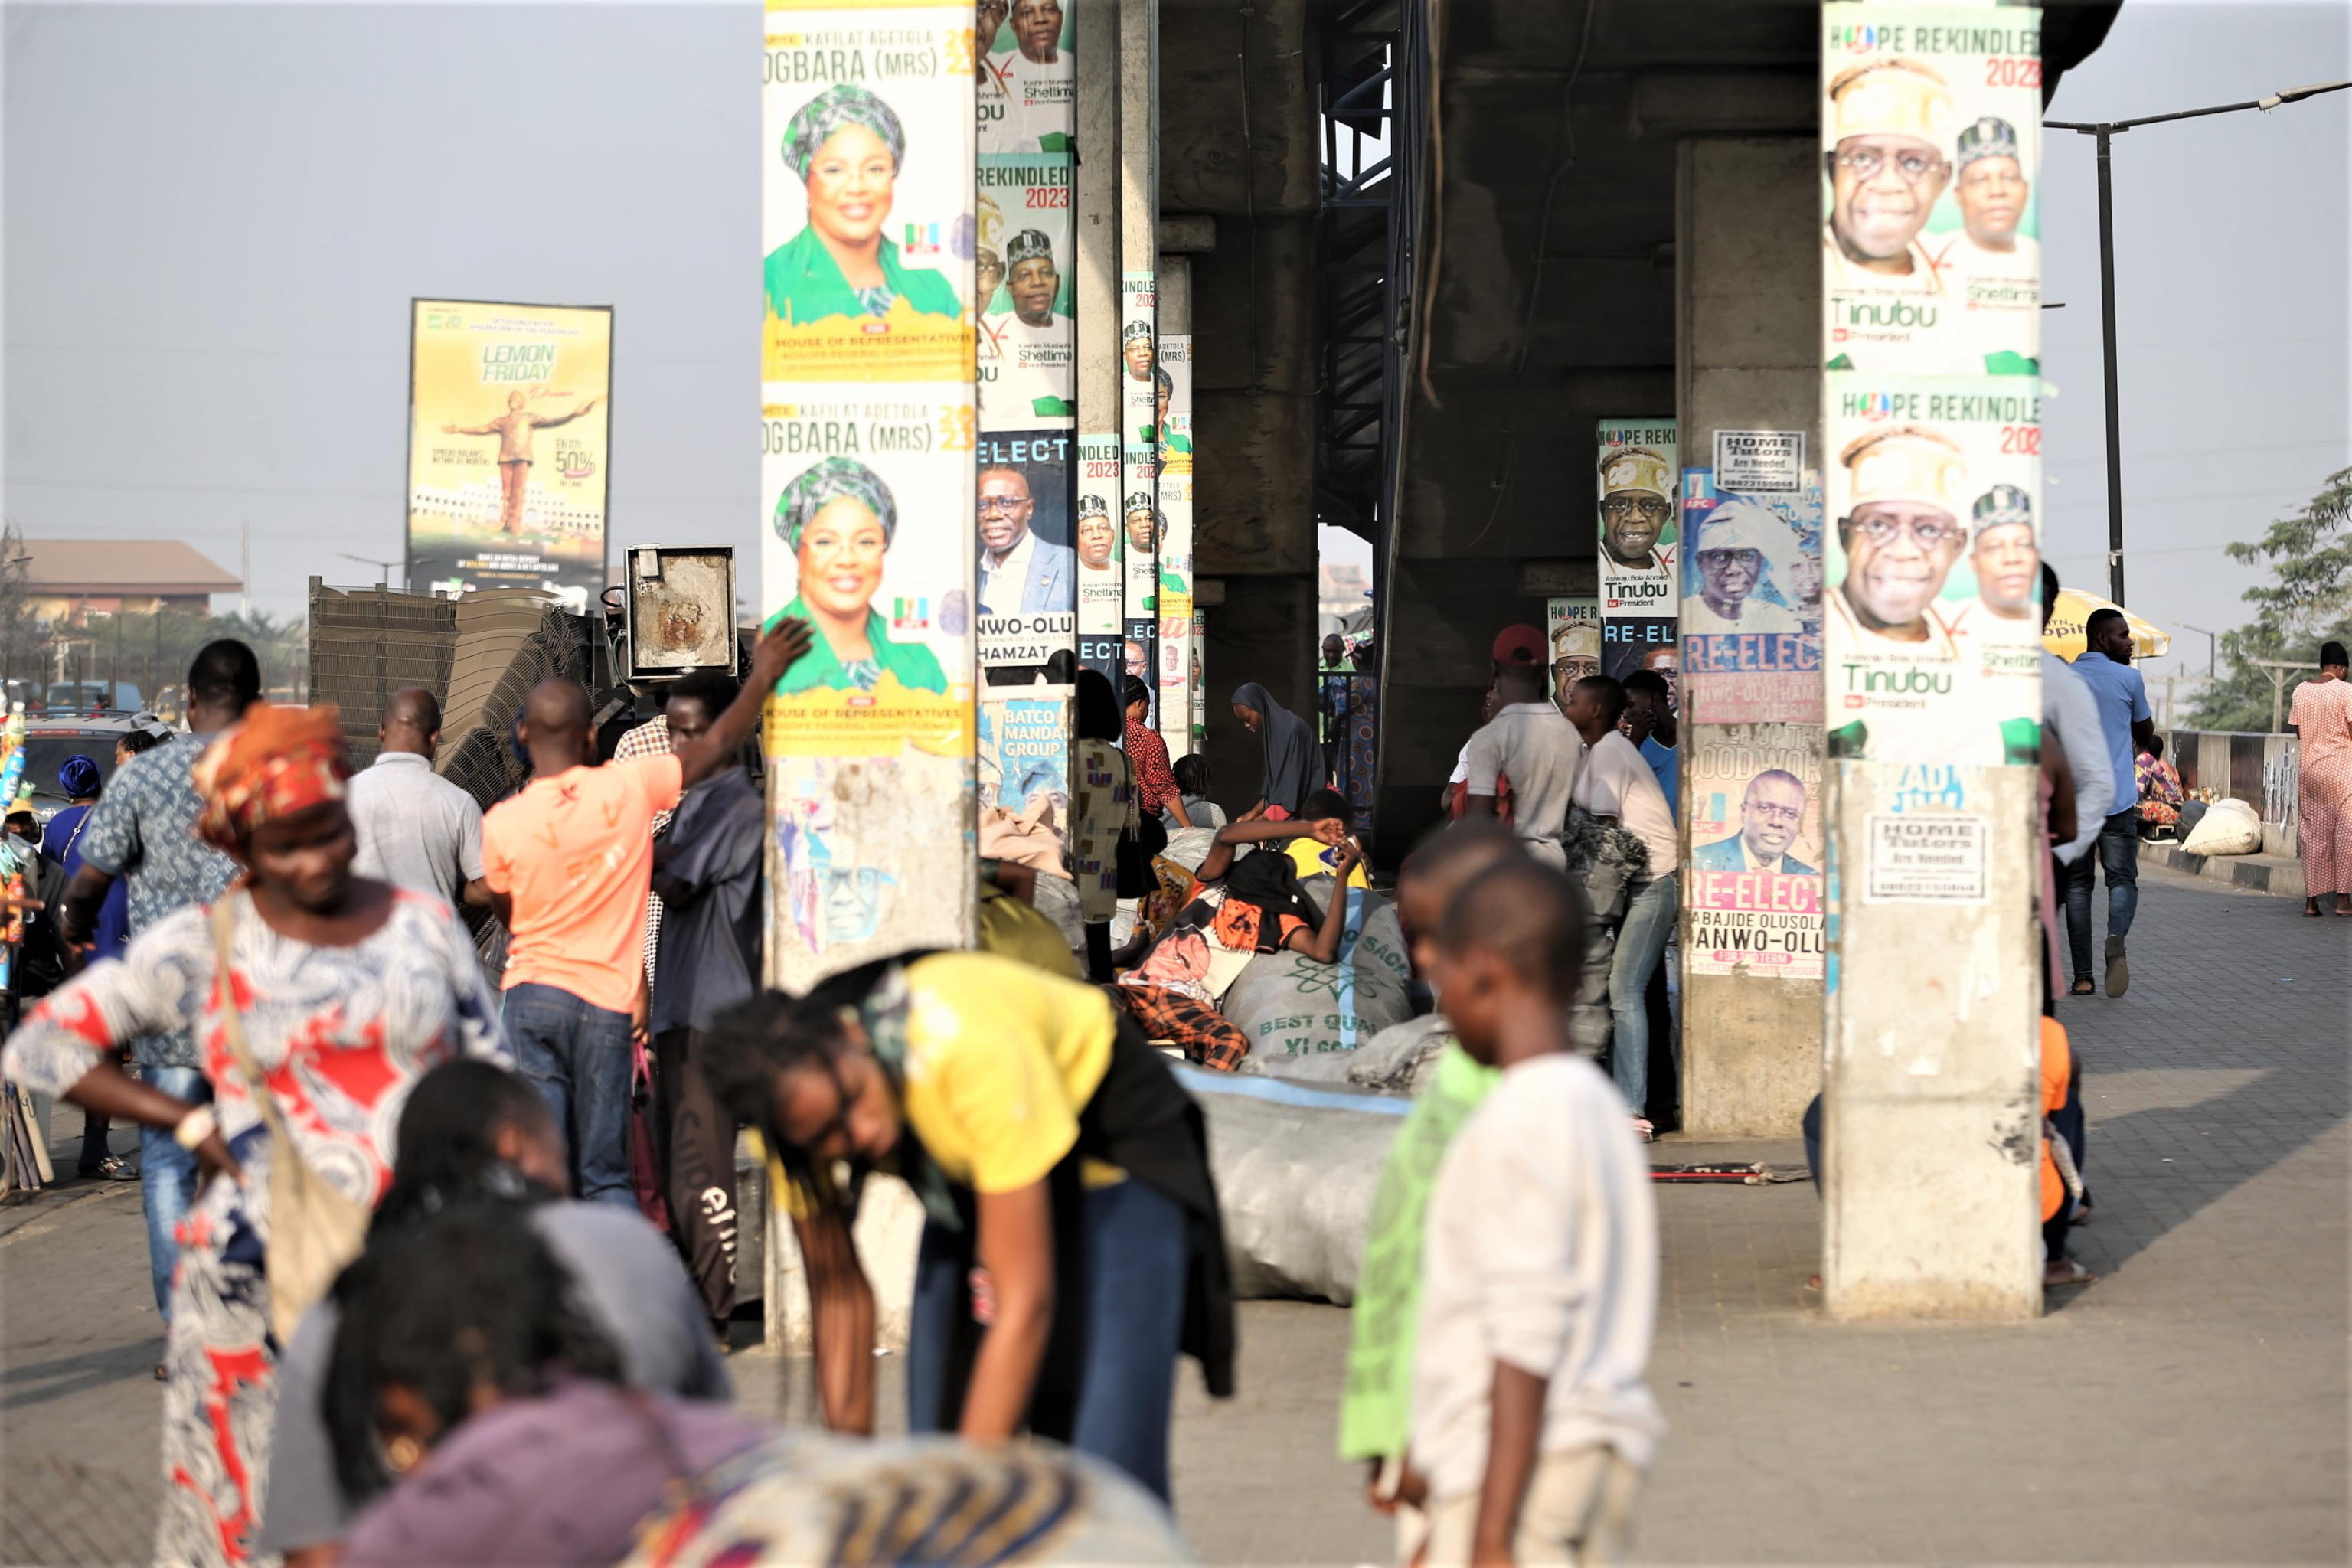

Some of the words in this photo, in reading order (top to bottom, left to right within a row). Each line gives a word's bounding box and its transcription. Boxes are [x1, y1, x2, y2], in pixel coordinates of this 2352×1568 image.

[1830, 25, 1906, 54] HOPE
[876, 47, 937, 79] (MRS)
[976, 166, 1069, 186] REKINDLED
[1026, 188, 1070, 208] 2023
[1831, 297, 1936, 328] Tinubu
[776, 338, 822, 348] HOUSE
[483, 345, 555, 364] LEMON
[1019, 350, 1073, 361] Shettima
[1161, 350, 1186, 363] (MRS)
[482, 363, 554, 381] FRIDAY
[800, 403, 858, 418] KAFILAT
[864, 403, 929, 418] ADETOLA
[1842, 392, 1921, 422] HOPE
[869, 422, 932, 454] (MRS)
[1599, 429, 1641, 447] HOPE
[1645, 429, 1676, 444] REKI
[1727, 438, 1792, 447] HOME
[978, 439, 1069, 463] ELECT
[1078, 446, 1119, 460] NDLED
[1727, 446, 1792, 456] Tutors
[556, 450, 596, 473] 50%
[1087, 461, 1119, 479] 2023
[1733, 459, 1749, 467] Are
[1687, 499, 1709, 508] APC
[1605, 581, 1668, 598] Tinubu
[1619, 599, 1654, 607] President
[1551, 606, 1586, 620] HOPE
[1590, 606, 1598, 619] R
[977, 617, 1072, 635] NWO-OLU
[1605, 626, 1674, 642] RE-EL
[978, 645, 1049, 660] HAMZAT
[1081, 642, 1122, 659] ECT
[1686, 635, 1816, 671] RE-ELEC
[1842, 664, 1952, 694] Tinubu
[1004, 710, 1055, 724] BATCO
[1004, 743, 1060, 757] GROUP
[1884, 824, 1972, 836] HOME
[1760, 952, 1788, 963] TERM
[1259, 1014, 1315, 1037] BEST
